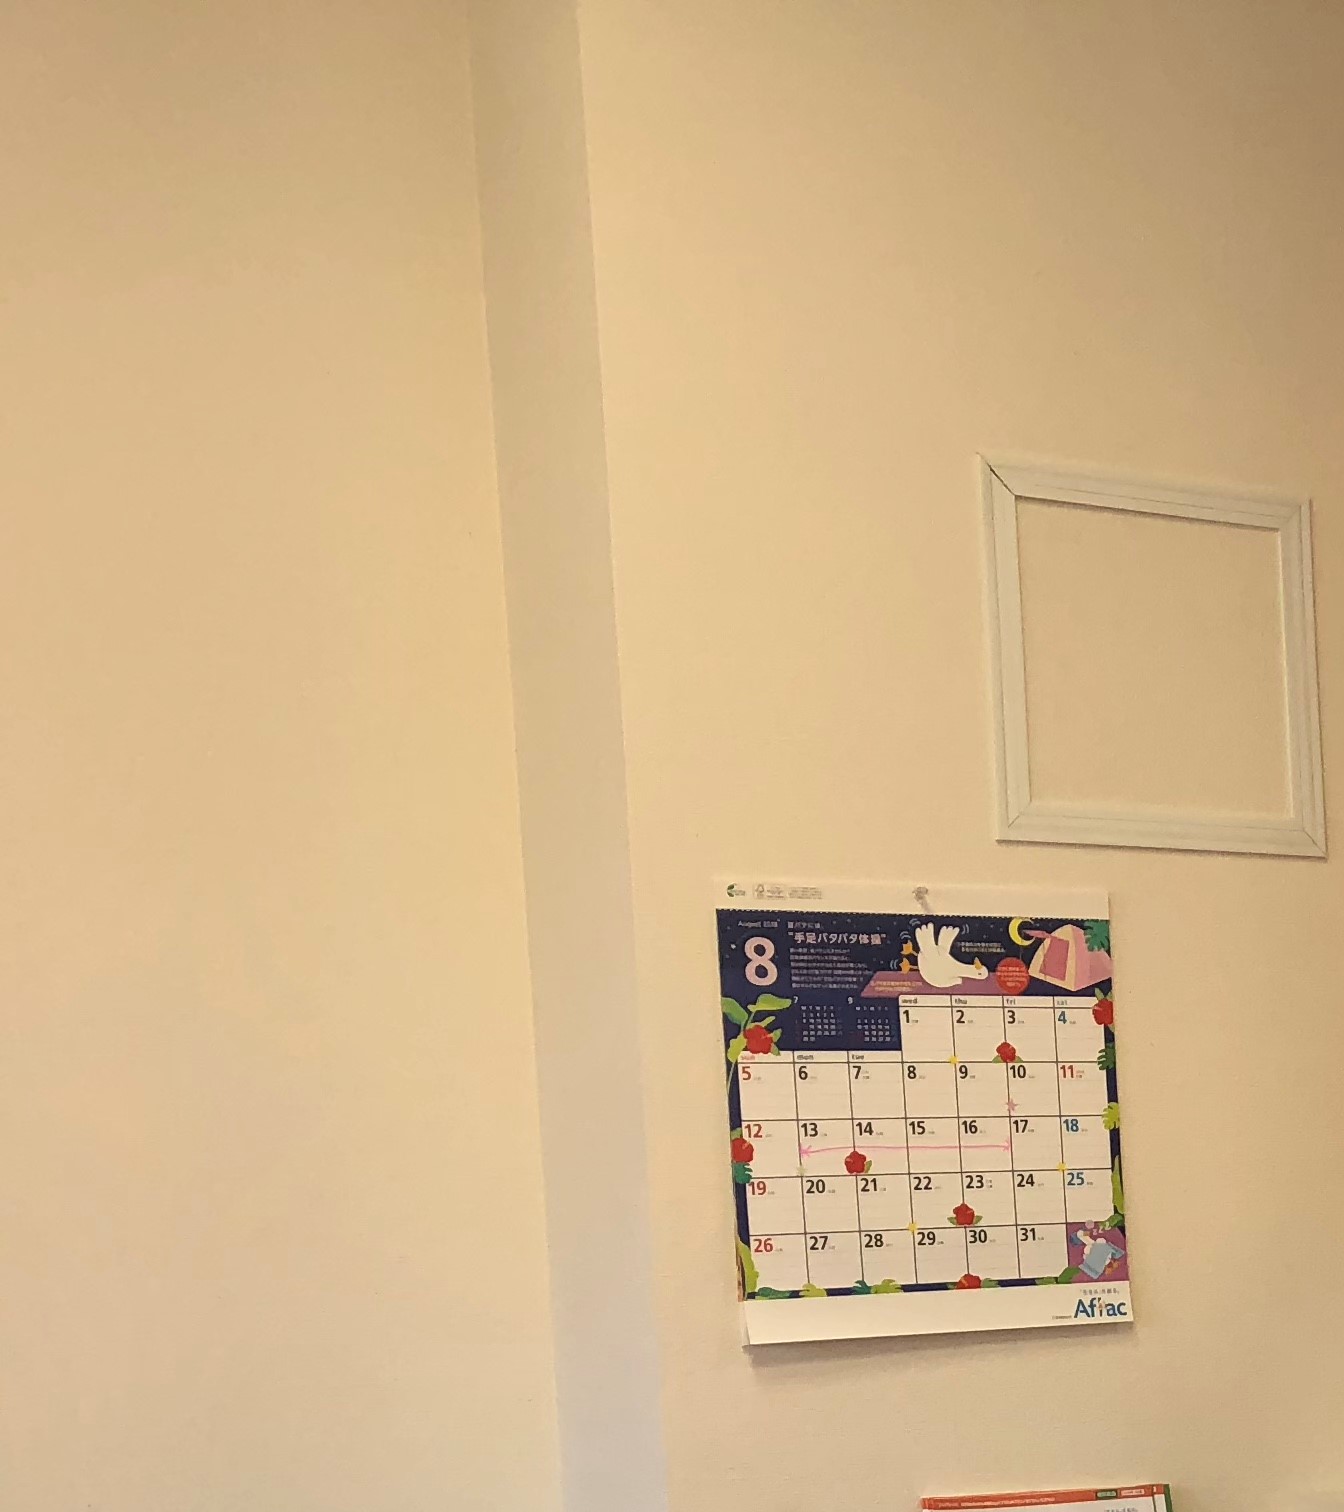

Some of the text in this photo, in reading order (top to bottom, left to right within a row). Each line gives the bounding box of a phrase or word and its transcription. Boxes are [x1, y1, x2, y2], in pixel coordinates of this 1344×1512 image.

[744, 936, 779, 987] 8
[903, 1010, 1067, 1024] 1 2 3 4
[742, 1065, 1074, 1081] 5 6 7 8 9 10 11
[744, 1118, 1079, 1138] 12 13 14 15 16 17 18
[749, 1172, 1085, 1195] 19 20 21 22 23 24 25
[753, 1227, 1036, 1253] 26 27 28 29 30 31
